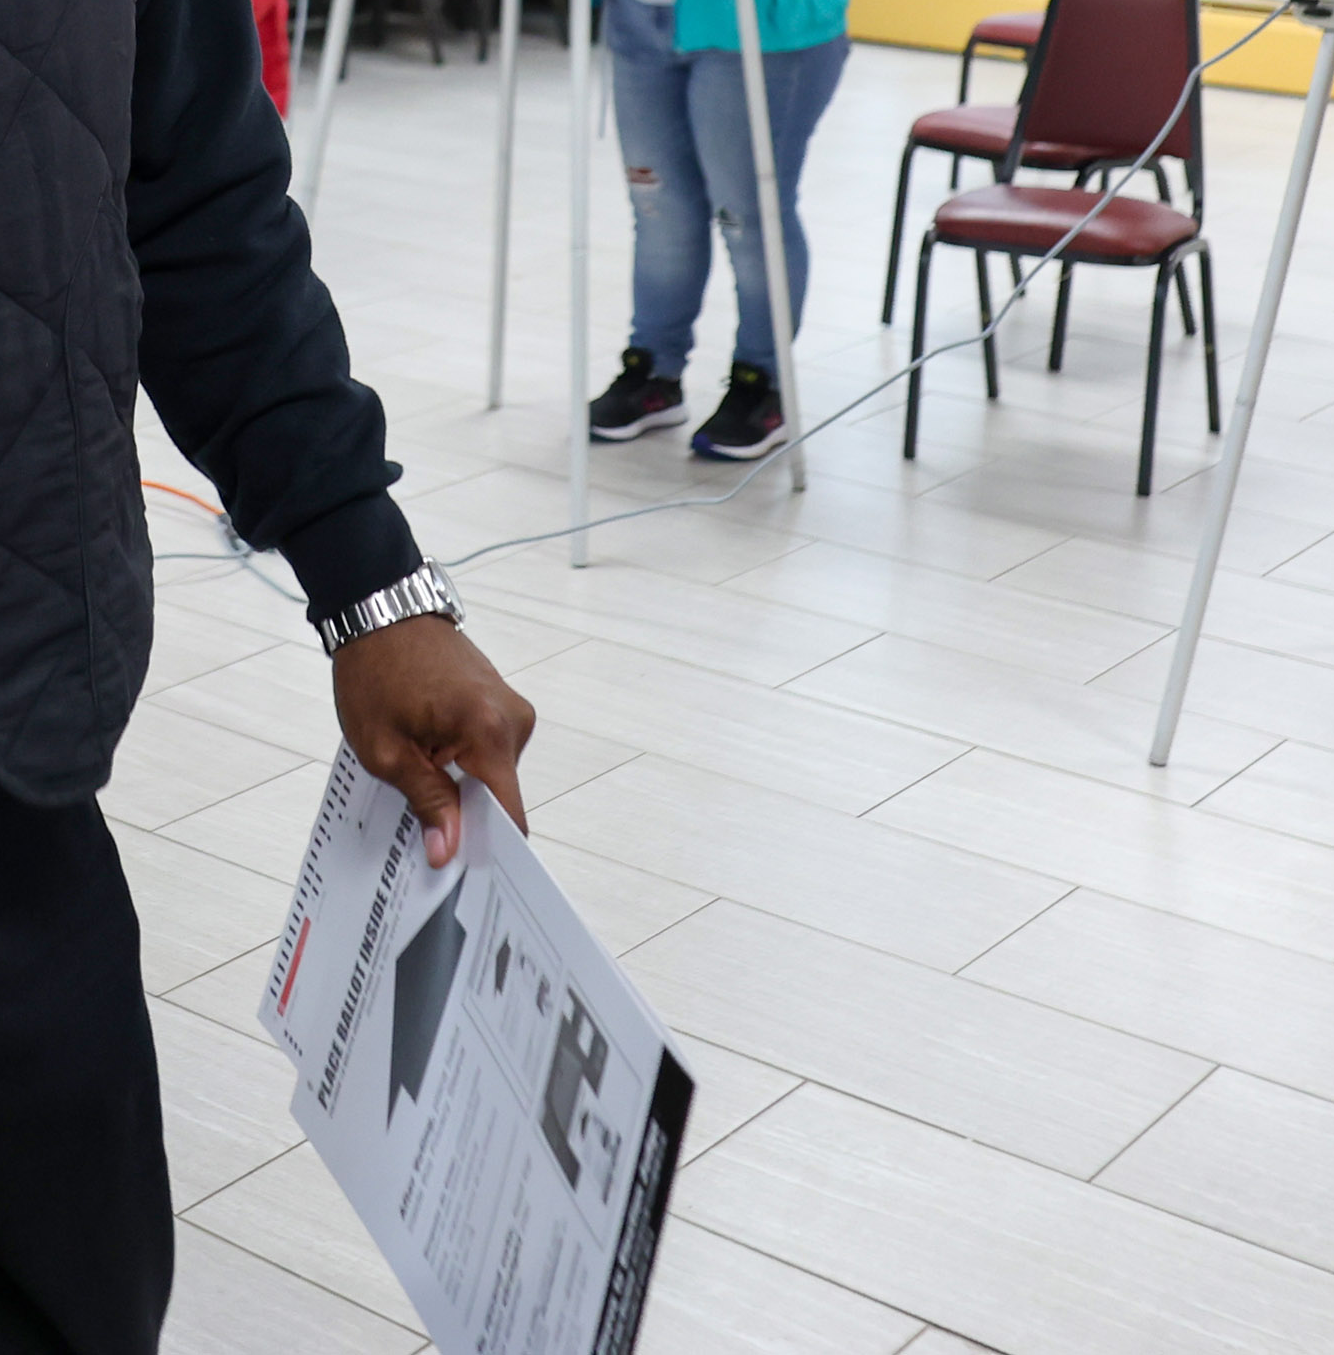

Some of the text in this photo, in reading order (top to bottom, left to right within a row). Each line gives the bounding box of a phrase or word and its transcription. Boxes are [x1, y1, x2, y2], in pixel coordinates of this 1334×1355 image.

[317, 1043, 344, 1111] PLACE
[336, 963, 366, 1038] BALLOT
[360, 888, 388, 962] INSIDE
[380, 844, 402, 892] FOR
